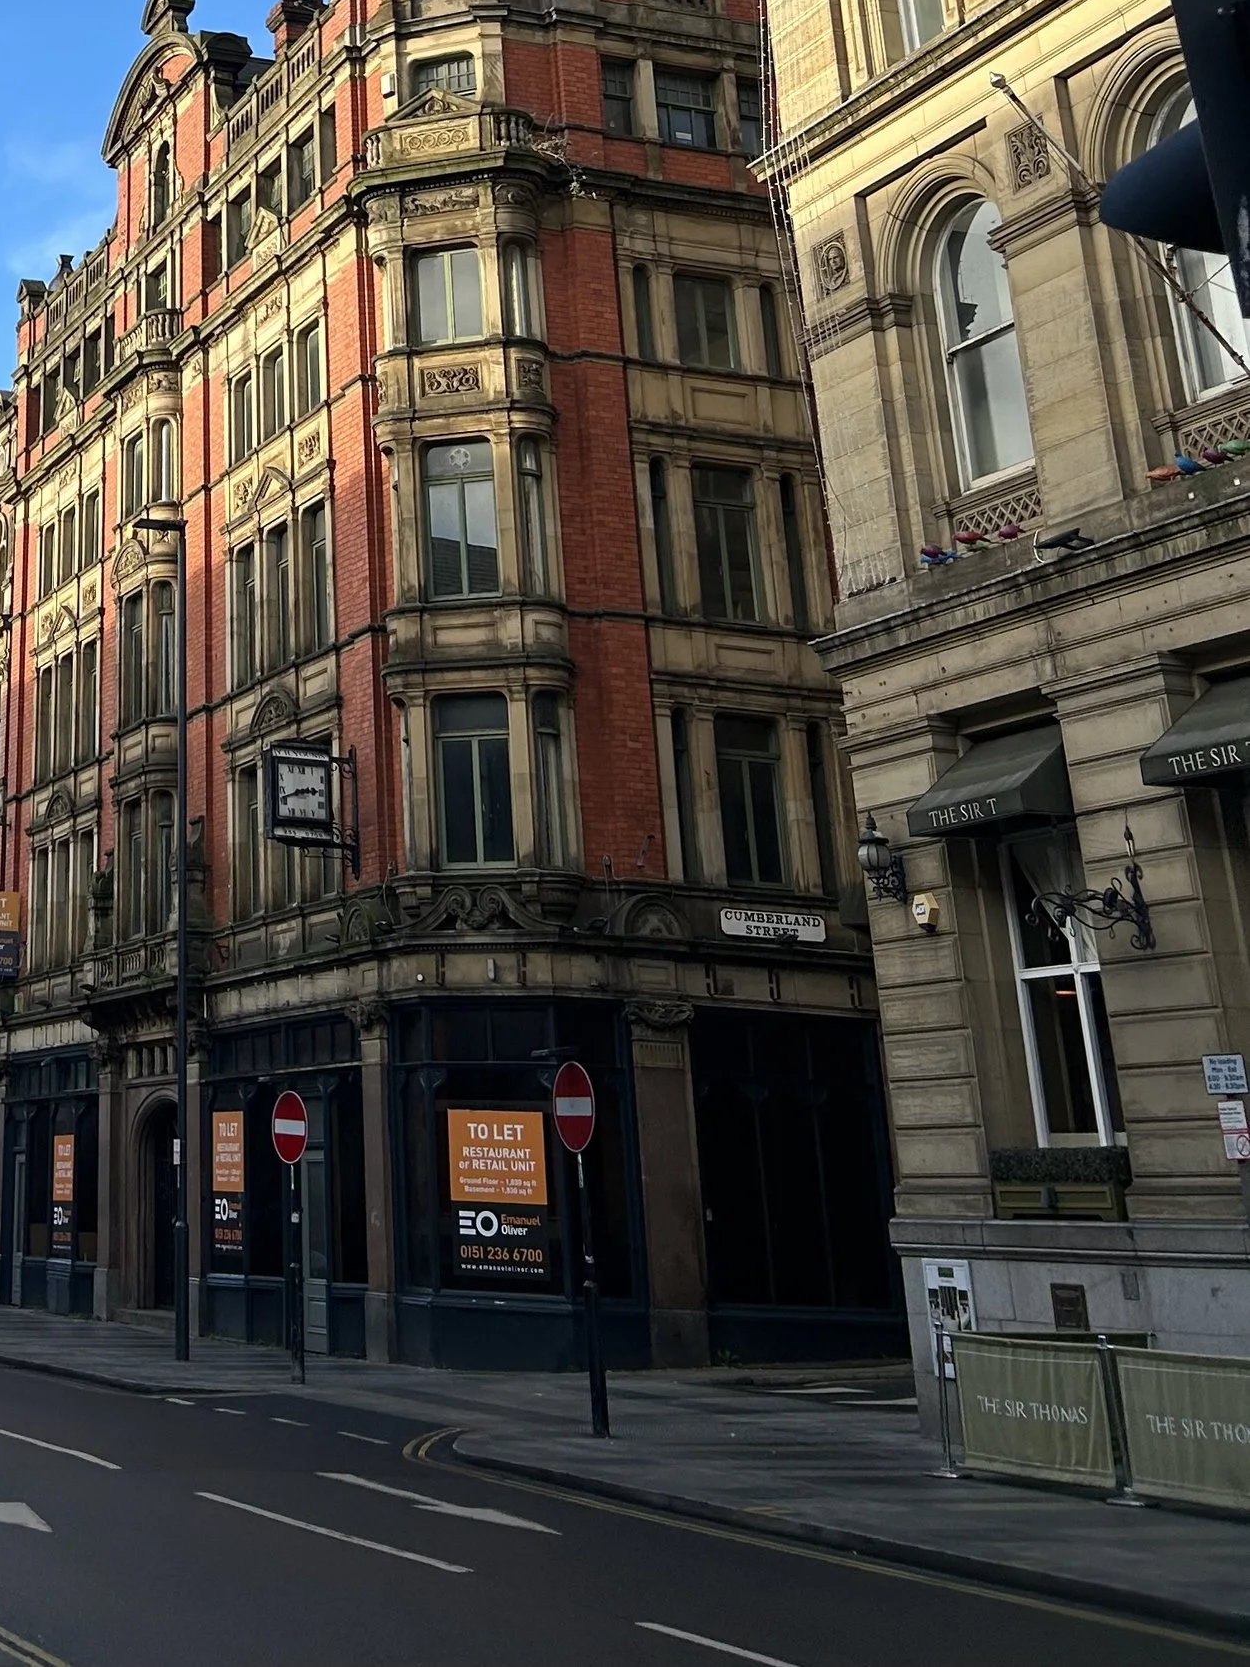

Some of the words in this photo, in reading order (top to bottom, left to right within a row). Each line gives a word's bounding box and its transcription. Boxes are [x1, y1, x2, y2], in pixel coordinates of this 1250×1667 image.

[1168, 751, 1207, 775] THE
[1210, 744, 1242, 767] SIR
[928, 806, 958, 827] THE
[960, 802, 985, 821] SIR
[986, 797, 997, 815] T
[724, 910, 821, 928] CUMBERLAND
[467, 1123, 488, 1140] TO
[493, 1123, 524, 1141] LET
[462, 1146, 531, 1159] RESTAURANT
[459, 1160, 469, 1170] or
[472, 1159, 509, 1171] RETAIL
[510, 1160, 536, 1172] UNIT
[459, 1176, 482, 1185] Ground
[464, 1185, 495, 1193] Basement
[501, 1214, 541, 1226] Emanuel
[501, 1224, 528, 1236] Oliver
[460, 1245, 484, 1259] 0151
[487, 1246, 510, 1260] 236
[513, 1247, 543, 1263] 6700
[977, 1395, 1002, 1415] THE
[1004, 1399, 1027, 1419] SIR
[1145, 1414, 1177, 1436] THE
[1181, 1417, 1208, 1439] SIR
[1210, 1421, 1250, 1444] THO
